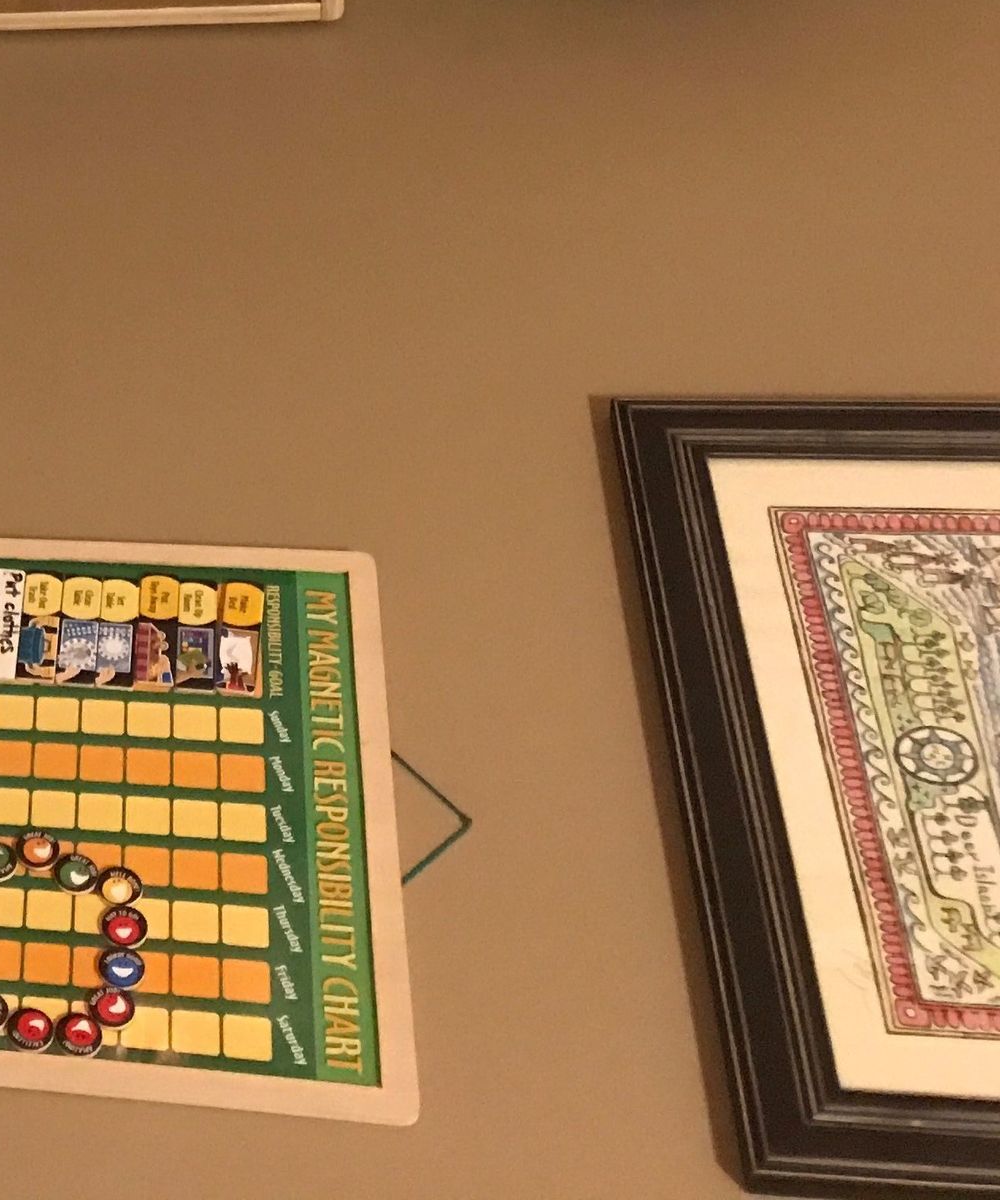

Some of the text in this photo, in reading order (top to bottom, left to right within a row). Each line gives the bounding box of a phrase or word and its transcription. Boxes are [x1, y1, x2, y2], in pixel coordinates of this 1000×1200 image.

[0, 572, 23, 654] Put clothes
[268, 710, 308, 1065] Sunday Monday Tuesday Wednesday Thursday Friday Saturday
[305, 589, 362, 1074] MY MAGNETIC RESPONSIBILITY CHART
[955, 815, 979, 861] Deer
